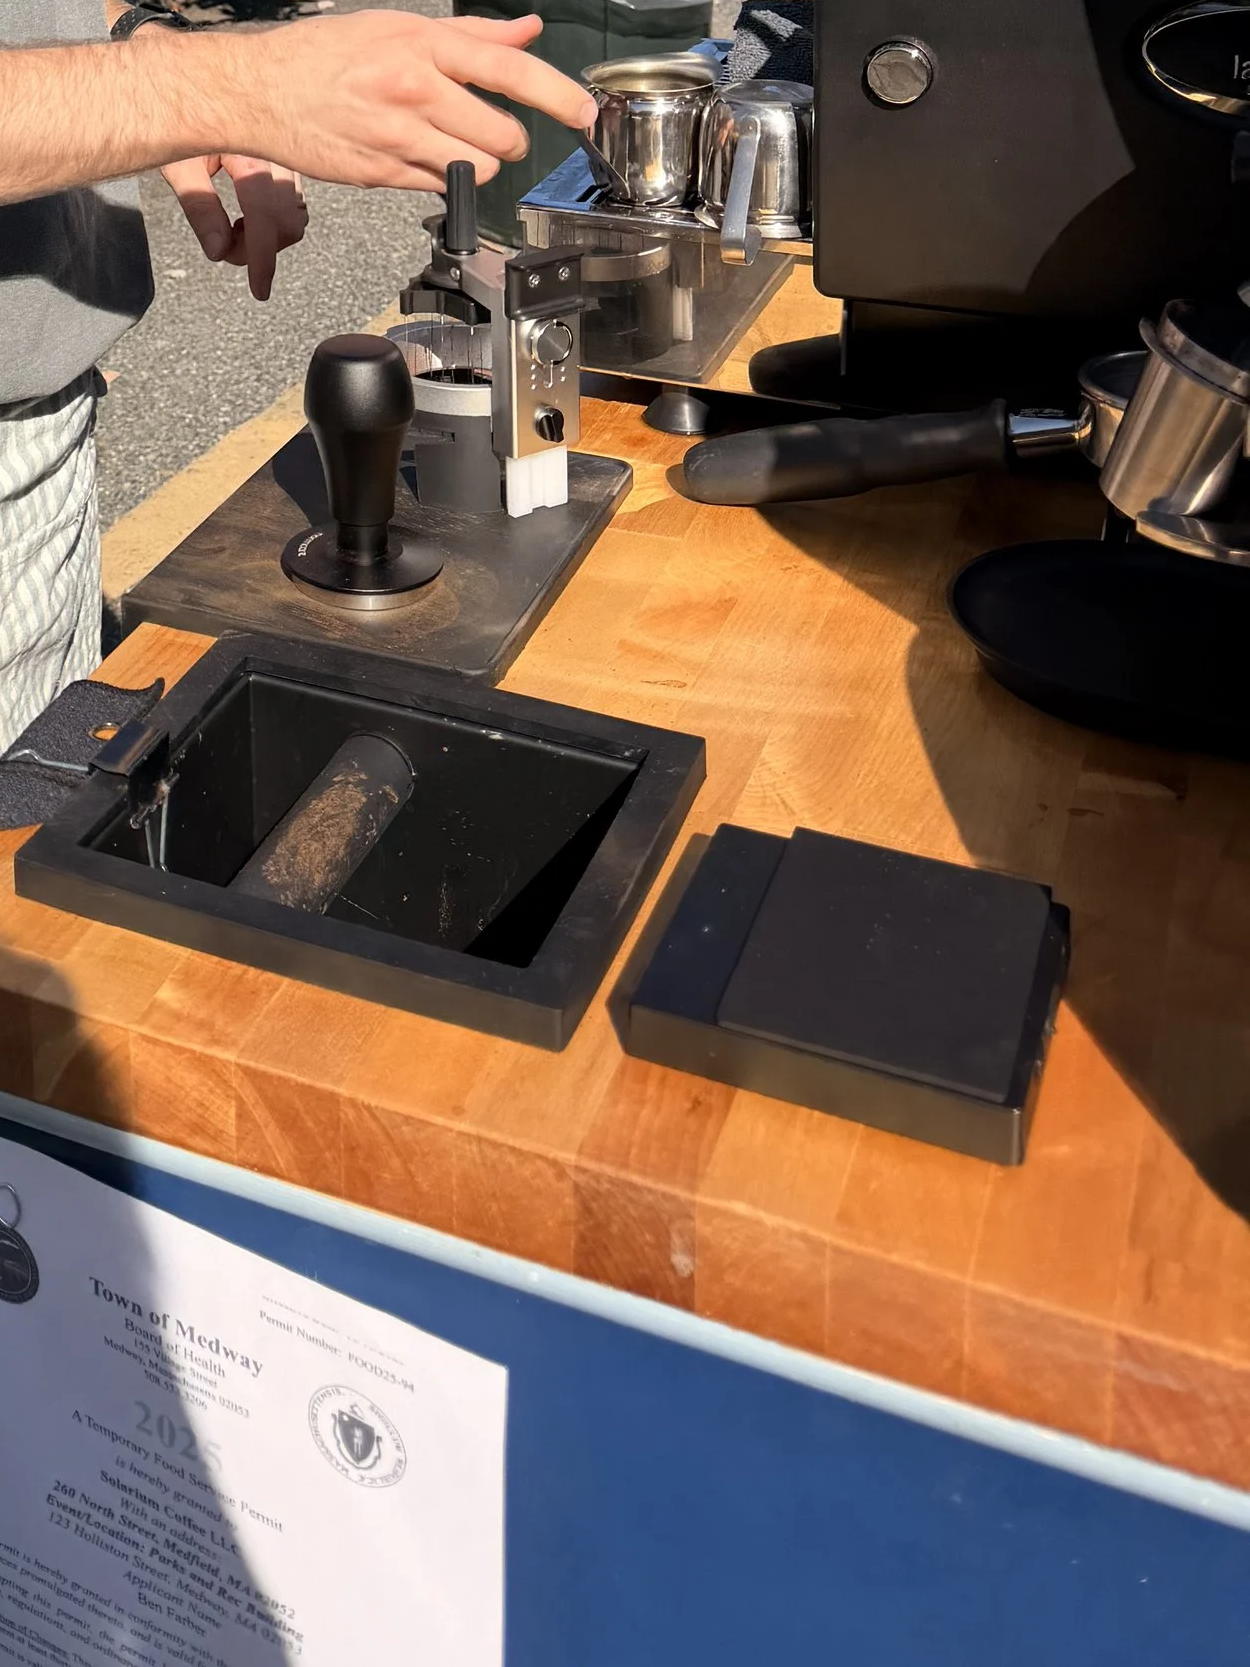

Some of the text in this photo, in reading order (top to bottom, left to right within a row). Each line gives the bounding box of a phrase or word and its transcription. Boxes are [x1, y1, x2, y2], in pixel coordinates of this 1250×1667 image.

[88, 1275, 143, 1318] Town
[149, 1311, 170, 1331] of
[175, 1318, 263, 1379] Medway
[103, 1334, 147, 1367] Medway,
[124, 1317, 226, 1379] Board of Health
[259, 1309, 293, 1334] Permit
[296, 1325, 342, 1358] Number:
[133, 1400, 223, 1472] 2025
[70, 1410, 284, 1534] A Temporary Food Service Permit
[115, 1455, 126, 1469] is
[129, 1461, 170, 1494] hereby
[173, 1490, 222, 1523] granted
[53, 1478, 77, 1499] 260
[78, 1492, 115, 1521] North
[162, 1538, 223, 1583] Medfield,
[227, 1574, 251, 1596] MA
[99, 1470, 241, 1559] Solarium Coffee LLC
[120, 1496, 149, 1522] With
[151, 1518, 167, 1532] an
[46, 1492, 146, 1554] Event/Location:
[148, 1545, 187, 1575] Parks
[188, 1571, 215, 1592] and
[217, 1585, 243, 1608] Rec
[48, 1511, 71, 1530] 123
[73, 1522, 130, 1562] Holliston
[234, 1612, 257, 1634] MA
[20, 1566, 87, 1608] promulgated
[130, 1628, 152, 1644] and
[153, 1637, 164, 1651] is
[22, 1553, 31, 1564] is
[34, 1557, 69, 1586] hereby
[71, 1581, 112, 1608] granted
[114, 1602, 126, 1615] in
[127, 1612, 188, 1648] conformity
[190, 1643, 214, 1662] with
[32, 1592, 52, 1609] this
[98, 1629, 116, 1644] the
[122, 1570, 223, 1631] Applicant Name
[137, 1592, 207, 1638] Ben Farber
[69, 1629, 91, 1645] and
